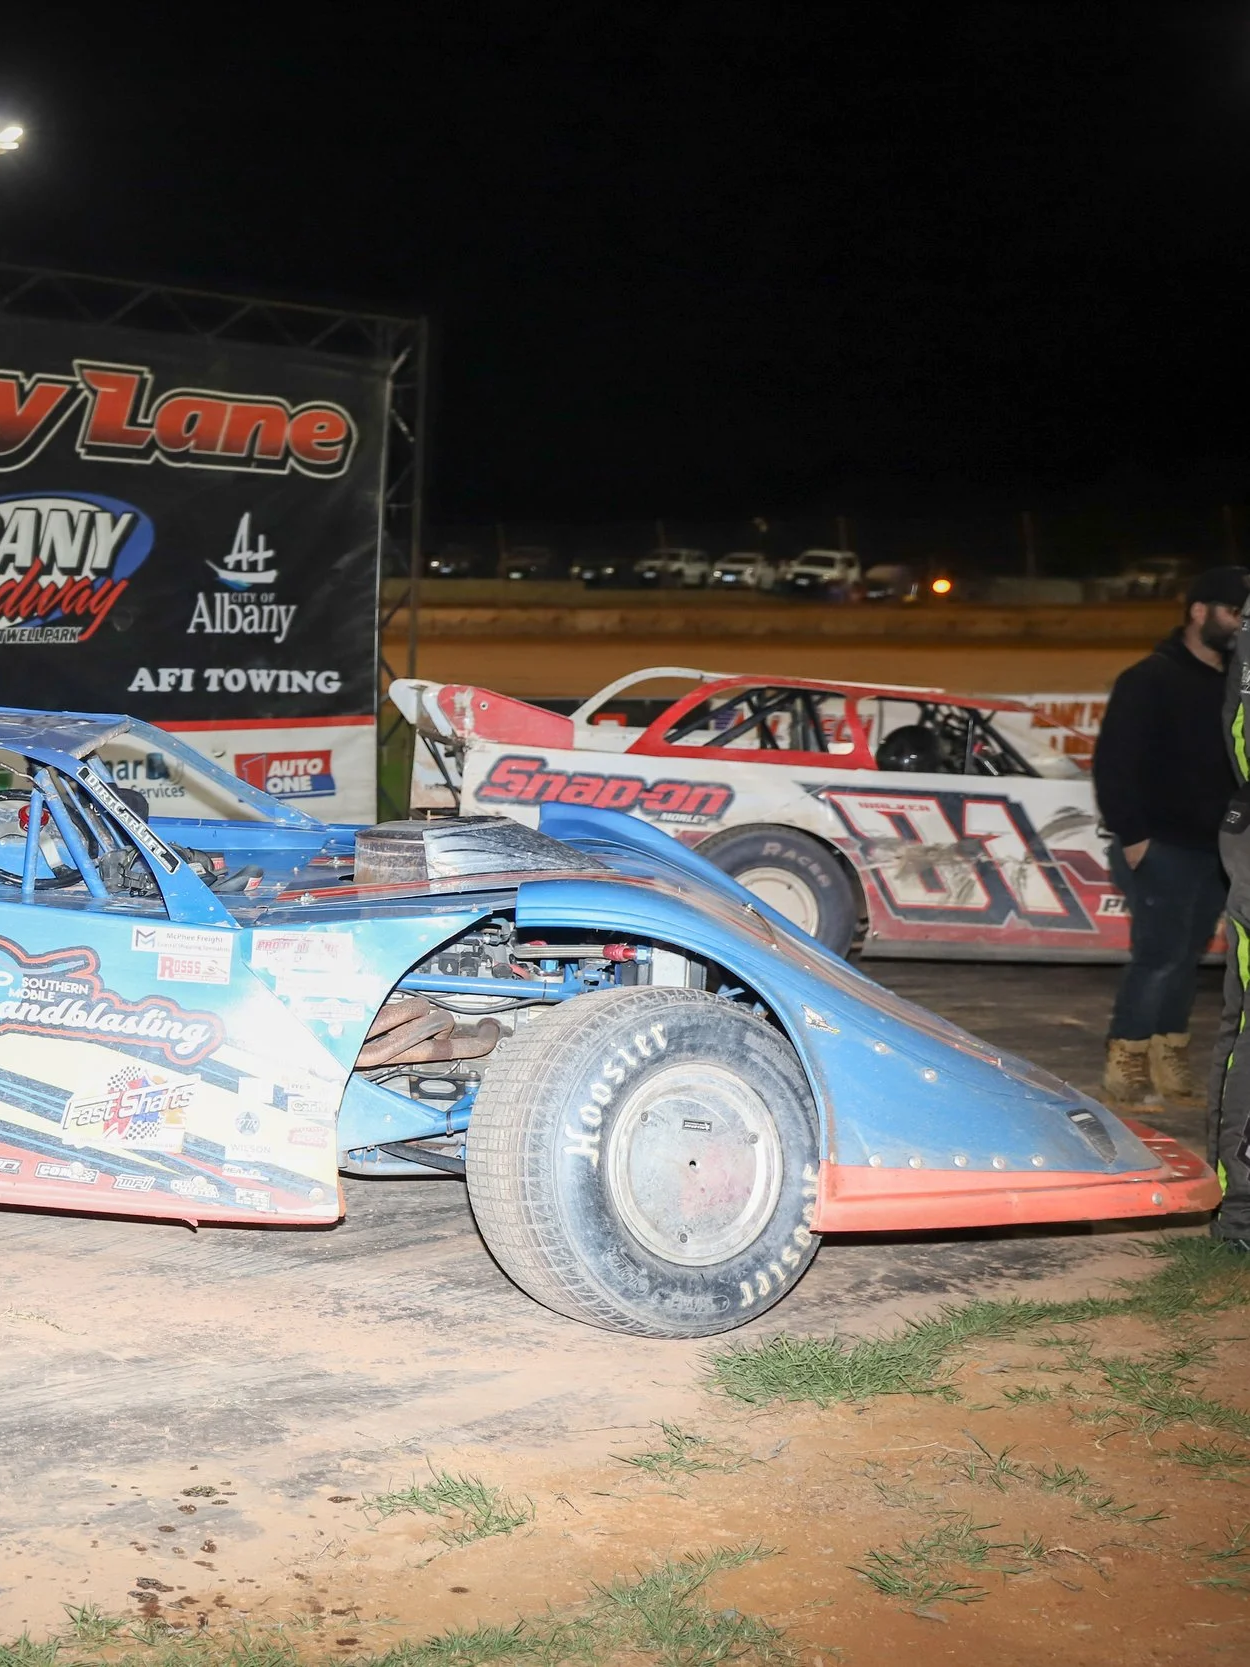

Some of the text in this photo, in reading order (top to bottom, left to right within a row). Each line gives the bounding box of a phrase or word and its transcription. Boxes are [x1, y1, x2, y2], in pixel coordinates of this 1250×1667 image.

[75, 361, 355, 475] Lane
[231, 593, 276, 603] CITY OF
[186, 592, 298, 644] Albany
[127, 667, 343, 694] AFI TOWING
[268, 758, 324, 776] AUTO
[265, 776, 312, 794] ONE
[477, 757, 733, 817] Snap-on
[8, 987, 56, 1002] MOBILE
[21, 975, 89, 996] SOUTHERN
